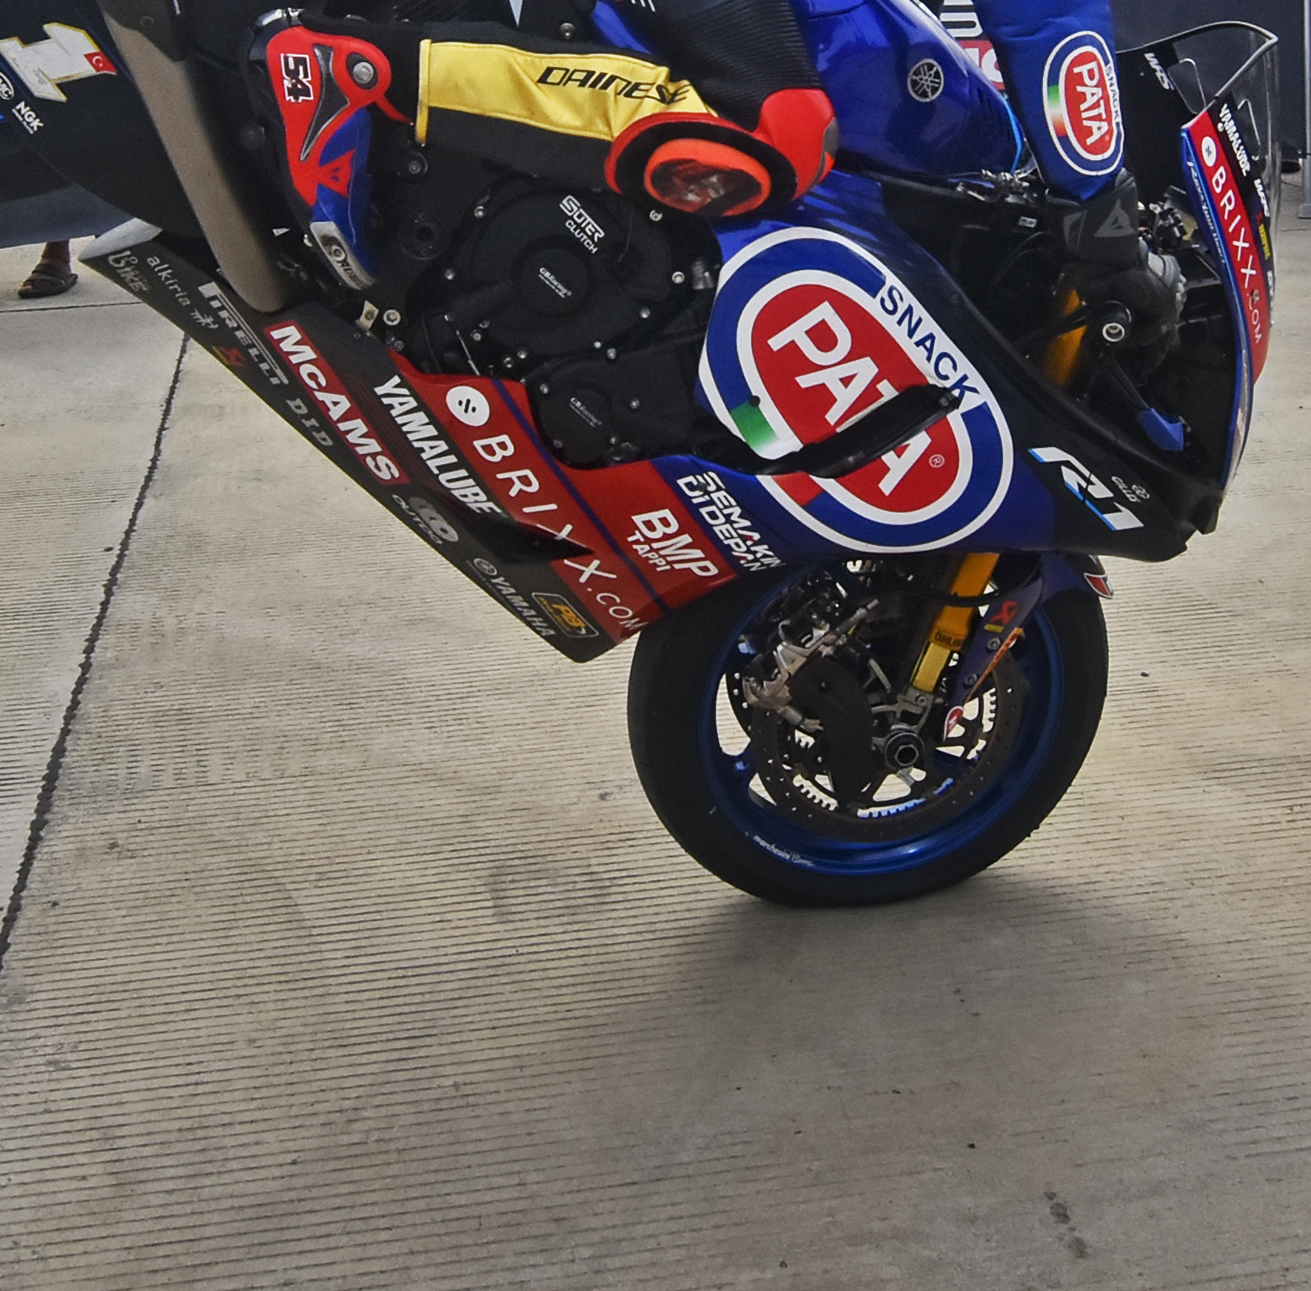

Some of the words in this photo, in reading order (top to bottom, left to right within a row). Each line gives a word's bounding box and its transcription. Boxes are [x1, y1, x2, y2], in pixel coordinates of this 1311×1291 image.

[281, 53, 314, 102] 54
[1073, 60, 1110, 146] PATA
[1105, 65, 1121, 120] SNACK
[15, 101, 44, 131] NGK
[559, 194, 605, 242] SUTER
[565, 219, 598, 255] CLUTCH
[146, 255, 191, 307] alkiria
[198, 281, 289, 385] PIRELLI
[879, 284, 980, 403] SNACK
[767, 301, 932, 497] PAA
[374, 375, 502, 514] YAMALUBE
[626, 530, 672, 571] TAPPI
[631, 508, 719, 577] BMP
[695, 471, 787, 569] SEMAKIN
[699, 505, 768, 571] DEPAN
[490, 576, 556, 637] YAMAHA
